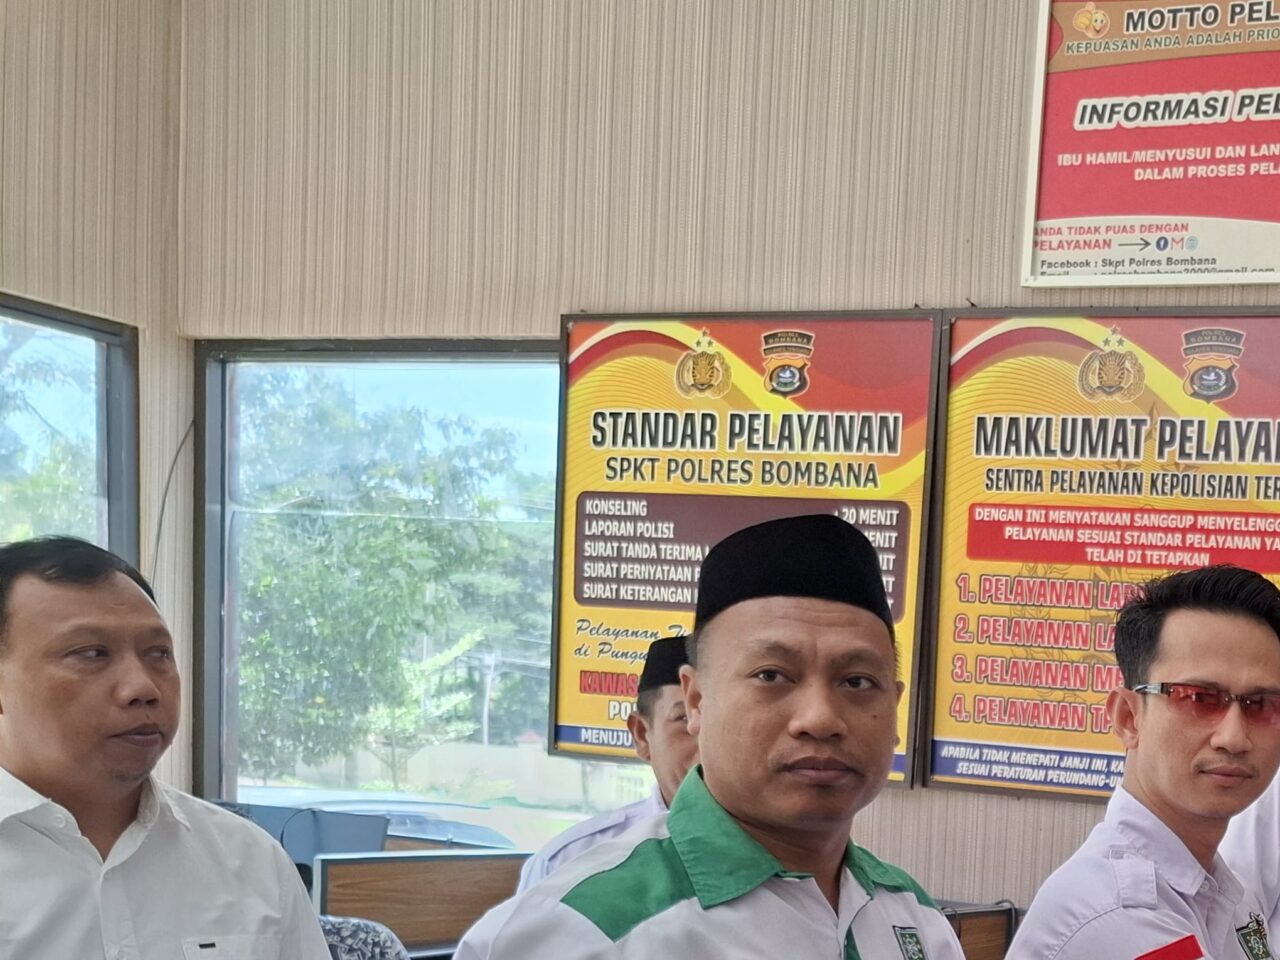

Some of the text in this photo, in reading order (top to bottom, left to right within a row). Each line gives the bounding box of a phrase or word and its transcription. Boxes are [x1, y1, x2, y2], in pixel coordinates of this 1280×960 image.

[1126, 4, 1219, 32] MOTTO
[1066, 39, 1139, 55] KEPUASAN
[1144, 37, 1183, 52] ANDA
[1186, 31, 1242, 49] ADALAH
[1079, 96, 1228, 126] INFORMASI
[1058, 153, 1081, 166] IBU
[1086, 145, 1211, 165] HAMIL/MENYUSUI
[1215, 144, 1246, 159] DAN
[1134, 165, 1184, 180] DALAM
[1188, 163, 1246, 178] PROSES
[1040, 256, 1217, 269] Facebook Skpt Polres Bombana
[592, 411, 899, 454] STANDAR PELAYANAN
[975, 416, 1147, 460] MAKLUMAT
[606, 457, 878, 488] SPKT POLRES BOMBANA
[985, 468, 1043, 492] SENTRA
[1050, 469, 1143, 495] PELAYANAN
[1149, 472, 1249, 499] KEPOLISIAN
[586, 500, 647, 516] KONSELING
[859, 509, 898, 526] MENIT
[975, 508, 1022, 522] DENGAN
[1026, 509, 1046, 523] INI
[1049, 510, 1129, 526] MENYATAKAN
[1134, 513, 1194, 529] SANGGUP
[585, 522, 674, 538] LAPORAN POLISI
[1005, 527, 1074, 542] PELAYANAN
[1077, 529, 1121, 544] SESUAI
[1125, 531, 1182, 547] STANDAR
[1186, 533, 1261, 551] PELAYANAN
[584, 542, 702, 561] SURAT TANDA TERIMA
[1086, 549, 1209, 567] TELAH DI TETAPKAN
[584, 563, 691, 581] SURAT PERNYATAAN
[583, 584, 691, 603] SURAT KETERANGAN
[981, 576, 1093, 607] PELAYANAN
[978, 617, 1089, 649] PELAYANAN
[977, 656, 1087, 690] PELAYANAN
[975, 697, 1087, 732] PELAYANAN
[941, 746, 1109, 774] APABILA TIDAK MENEPATI JANJI INI,
